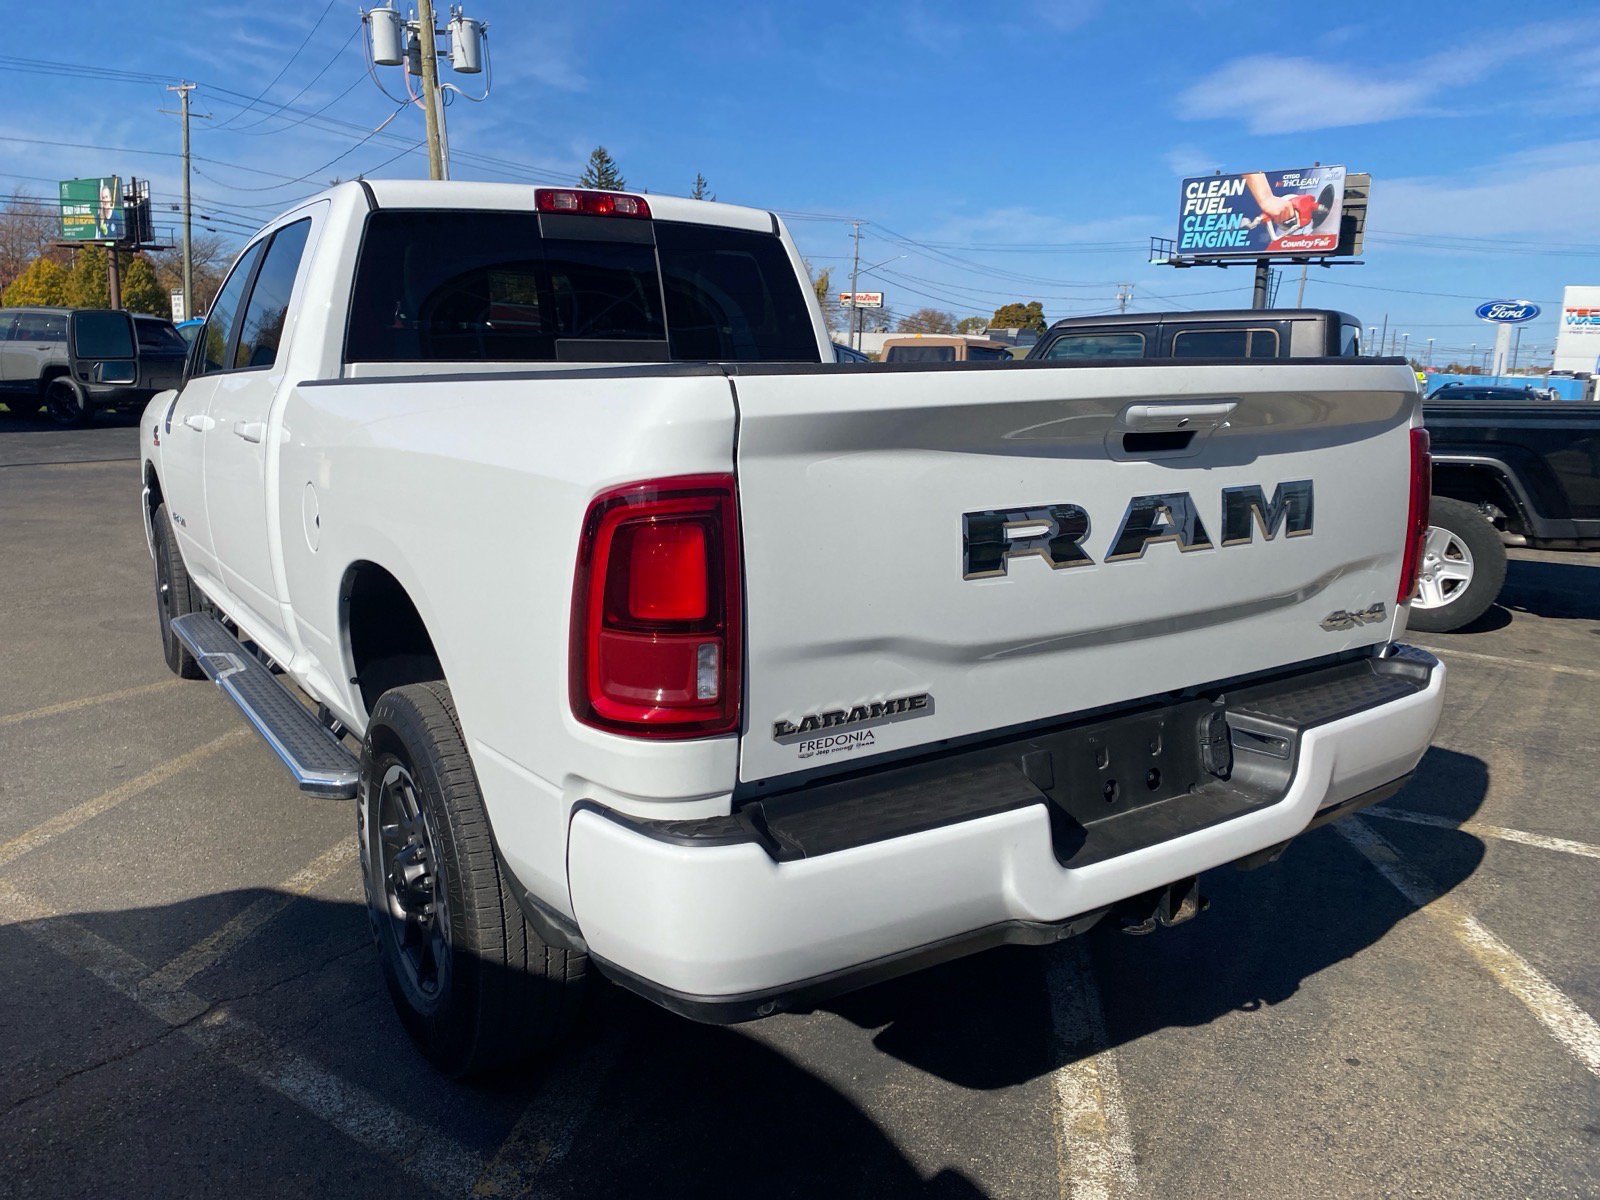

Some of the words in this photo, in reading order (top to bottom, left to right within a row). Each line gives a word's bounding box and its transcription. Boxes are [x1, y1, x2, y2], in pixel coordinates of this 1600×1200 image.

[1186, 179, 1247, 198] CLEAN
[1184, 198, 1232, 215] FUEL.
[1183, 213, 1243, 232] CLEAN
[1181, 230, 1250, 248] ENGINE.
[1281, 240, 1315, 249] Country
[1314, 238, 1331, 247] Fair
[1487, 303, 1527, 319] Ford
[962, 479, 1314, 581] RAM
[773, 692, 930, 738] LARAMIE
[799, 730, 875, 752] FREDONIA
